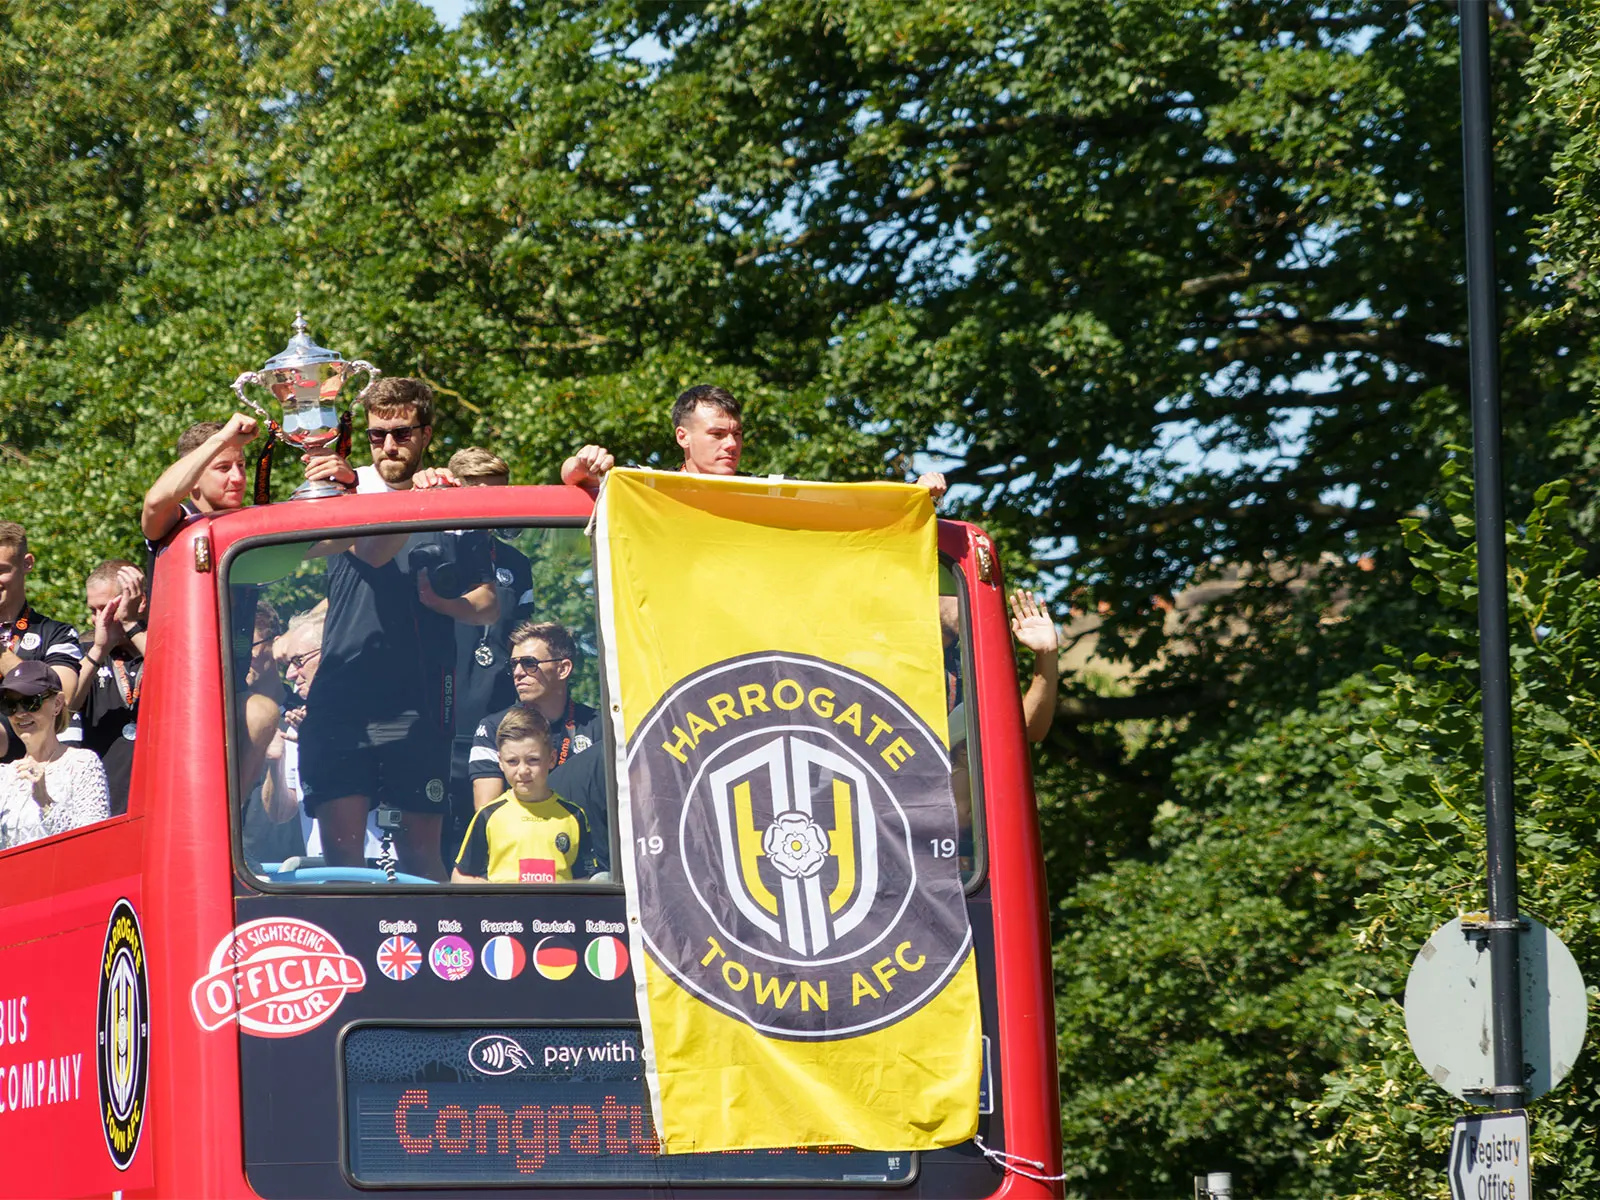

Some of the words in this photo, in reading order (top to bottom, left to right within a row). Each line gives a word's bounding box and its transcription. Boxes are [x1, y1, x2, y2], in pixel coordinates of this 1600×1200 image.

[444, 674, 453, 694] EOS
[662, 679, 916, 772] HARROGATE
[637, 836, 664, 856] 19
[930, 838, 956, 859] 19
[247, 925, 326, 952] SIGHTSEEING
[379, 920, 417, 935] English
[438, 920, 463, 932] Kids
[481, 920, 524, 935] Français
[533, 920, 576, 933] Deutsch
[586, 920, 625, 933] Italiano
[105, 916, 142, 979] HARROGATE
[434, 945, 473, 967] Kids
[206, 958, 359, 1014] OFFICIAL
[700, 937, 829, 1012] TOWN
[852, 940, 926, 1006] AFC
[266, 992, 330, 1024] TOUR
[544, 1046, 584, 1067] pay
[587, 1039, 635, 1062] with
[106, 1102, 126, 1152] TOWN
[127, 1099, 140, 1149] AFC
[1470, 1133, 1520, 1169] Registry
[1478, 1173, 1516, 1200] Office
